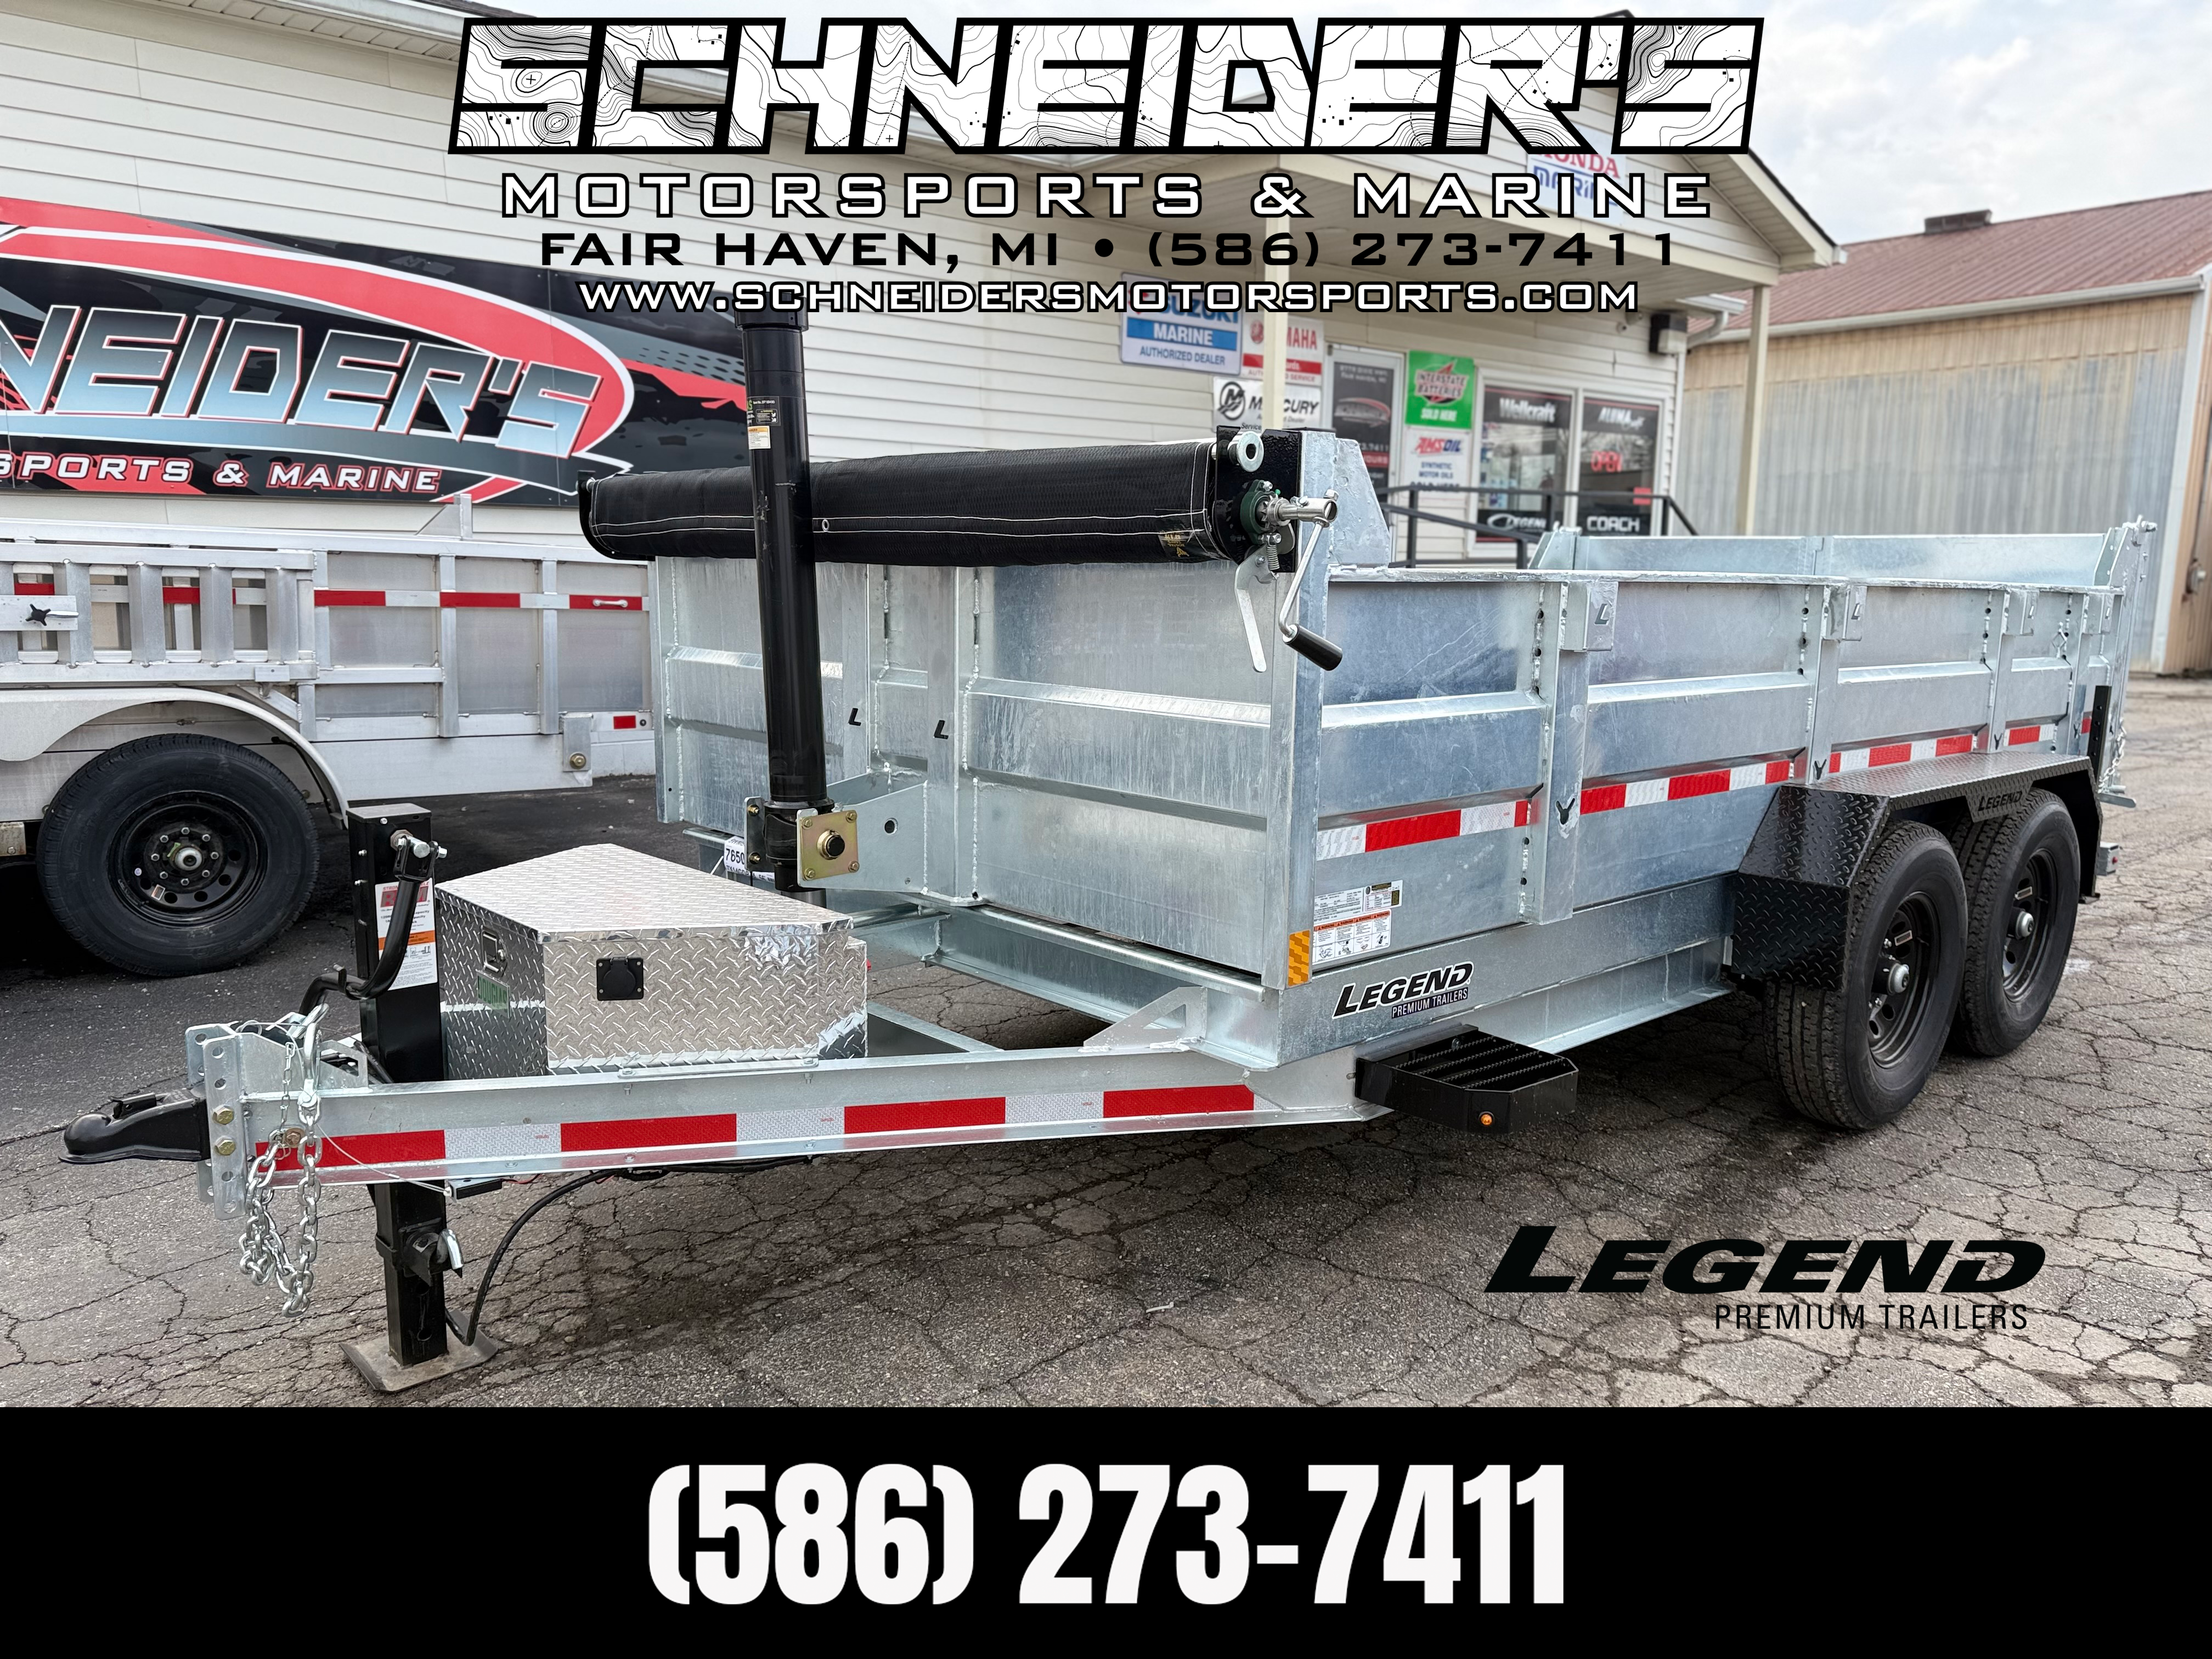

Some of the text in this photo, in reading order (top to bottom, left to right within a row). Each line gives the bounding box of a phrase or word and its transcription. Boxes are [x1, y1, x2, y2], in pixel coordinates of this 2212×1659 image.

[1536, 154, 1621, 179] NDA
[1154, 323, 1214, 346] MARINE
[1139, 346, 1225, 365] AUTHORIZED DEALER
[1417, 371, 1465, 386] INTERSTATE
[1417, 385, 1462, 397] BATTERIES
[1249, 396, 1319, 415] MCURY
[1499, 398, 1556, 422] Wellcraft
[1415, 437, 1462, 454] AMSOIL
[213, 460, 249, 487] &
[266, 462, 442, 493] MARINE
[1587, 516, 1640, 532] COACH
[1978, 791, 2023, 811] LEGEND
[1332, 962, 1474, 1018] LEGEND
[1392, 989, 1468, 1017] PREMIUM TRAILERS
